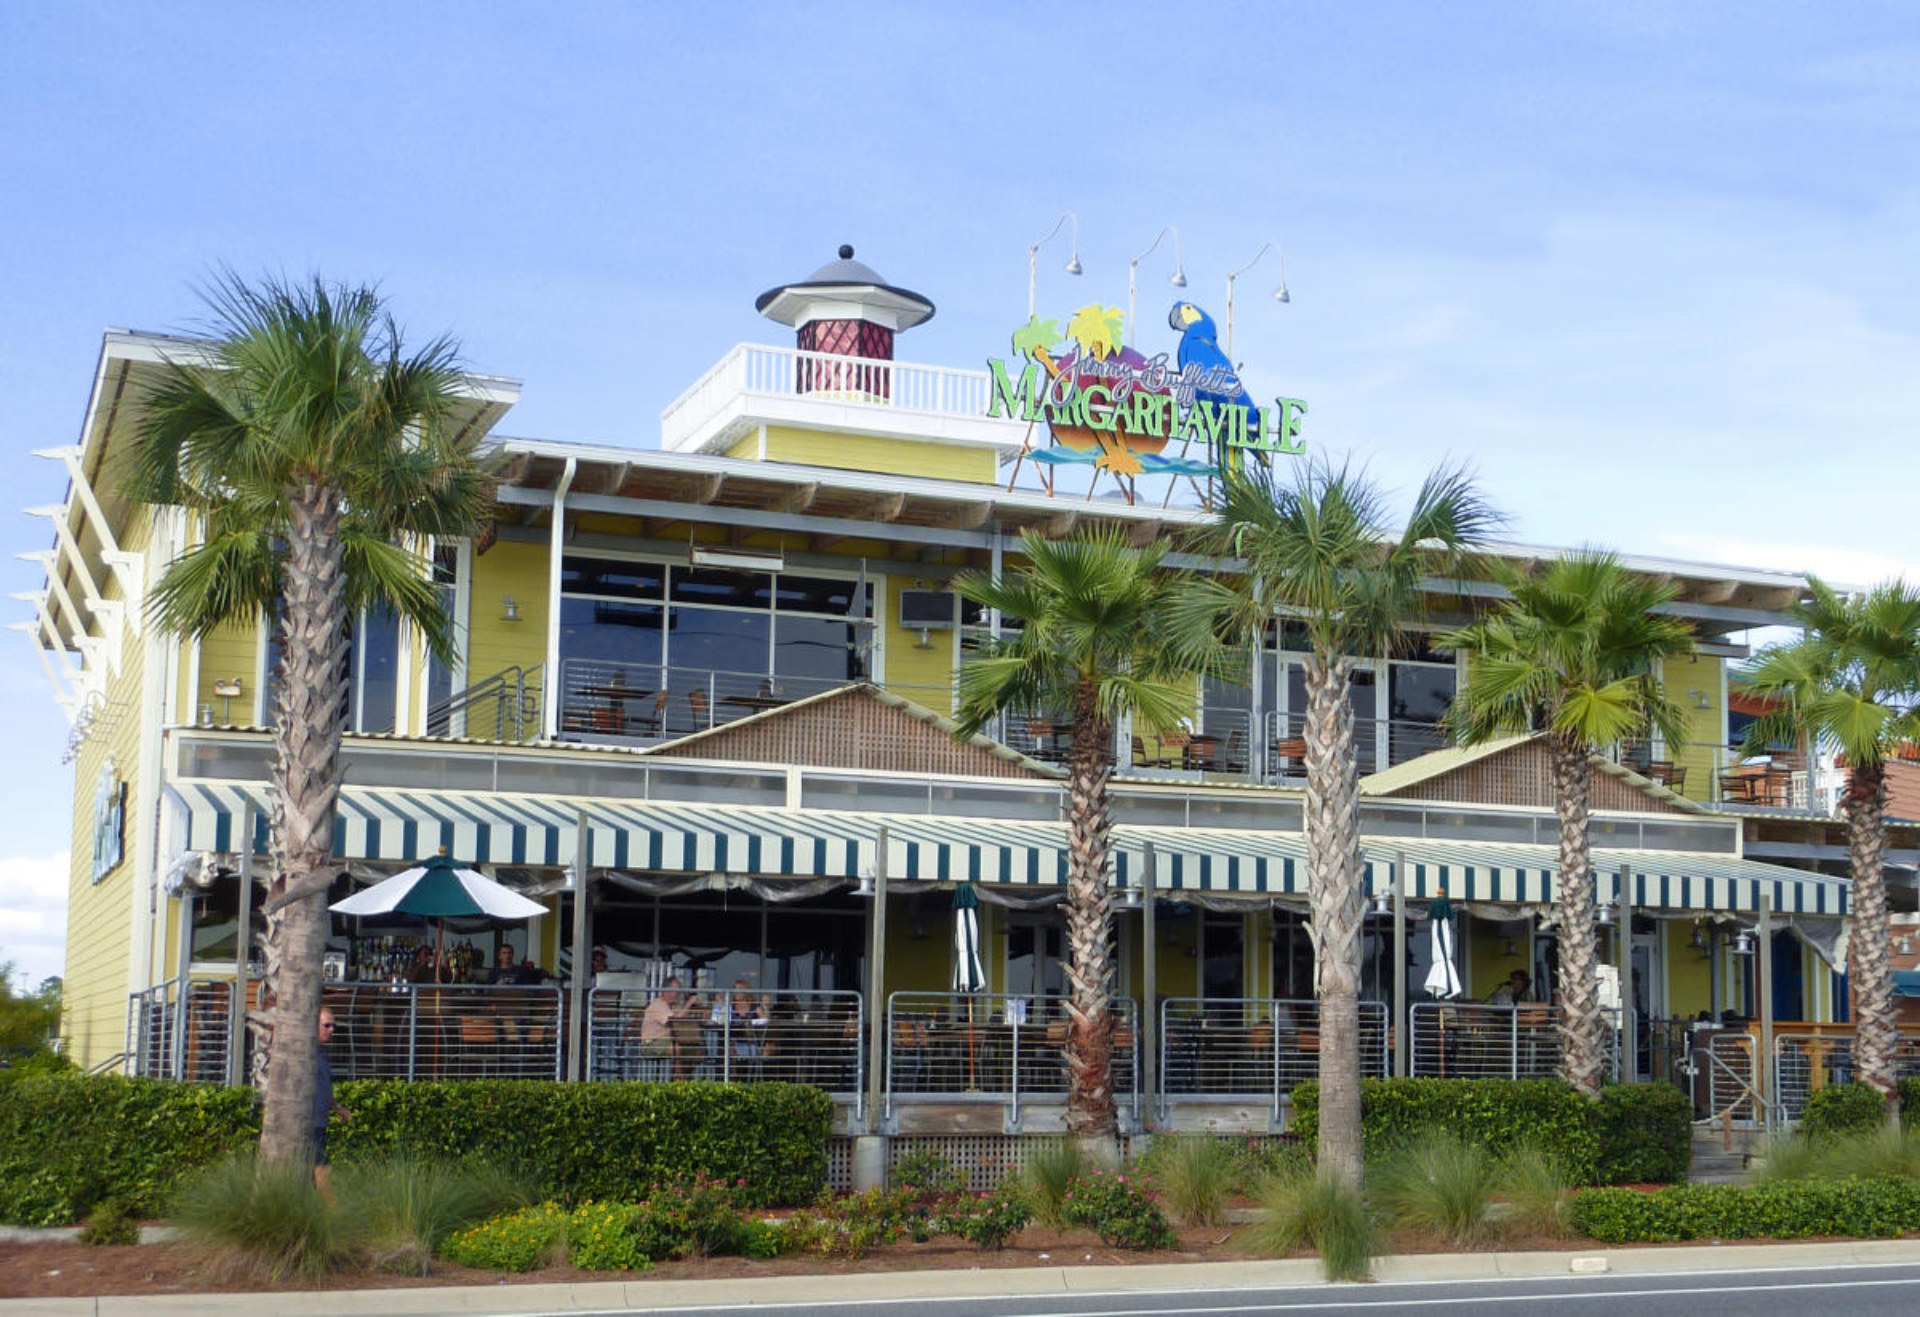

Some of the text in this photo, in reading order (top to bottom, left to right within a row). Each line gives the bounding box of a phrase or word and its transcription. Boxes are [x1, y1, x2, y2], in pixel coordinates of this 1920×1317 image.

[987, 358, 1308, 454] MARGARITAVILLE
[1051, 343, 1244, 407] Jimmy Buffett's
